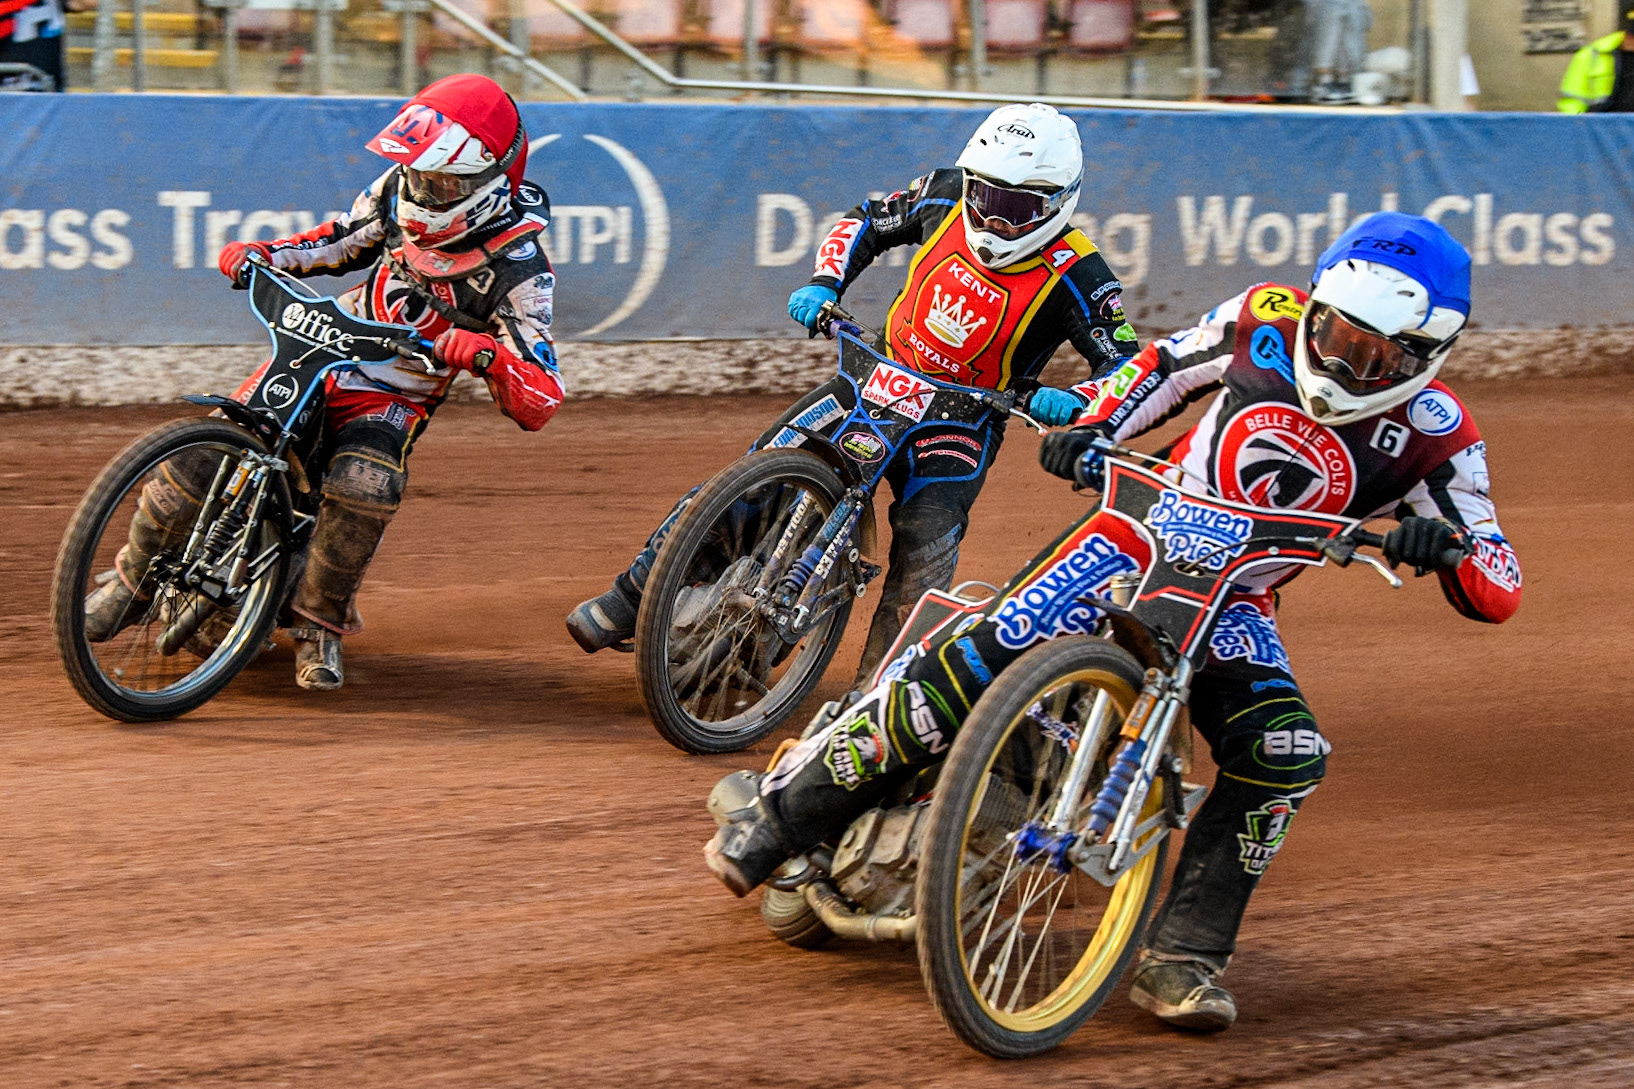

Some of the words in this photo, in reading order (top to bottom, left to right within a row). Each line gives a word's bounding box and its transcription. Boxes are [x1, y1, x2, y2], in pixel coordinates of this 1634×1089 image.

[998, 124, 1035, 139] Arai
[820, 220, 857, 276] NGK
[1052, 249, 1076, 268] 4
[948, 262, 1001, 304] KENT
[909, 332, 960, 374] ROYALS
[269, 383, 293, 400] ATPI
[864, 389, 889, 404] SPARK
[868, 367, 932, 410] NGK
[1420, 397, 1451, 425] ATPI
[1244, 413, 1292, 433] BELLE
[1297, 420, 1328, 449] VUE
[1323, 447, 1346, 497] COLTS
[1377, 423, 1403, 453] 6
[1151, 491, 1251, 539] Bowen
[1166, 532, 1226, 567] Pies
[998, 536, 1118, 647] Bowen
[1263, 729, 1332, 757] BSN
